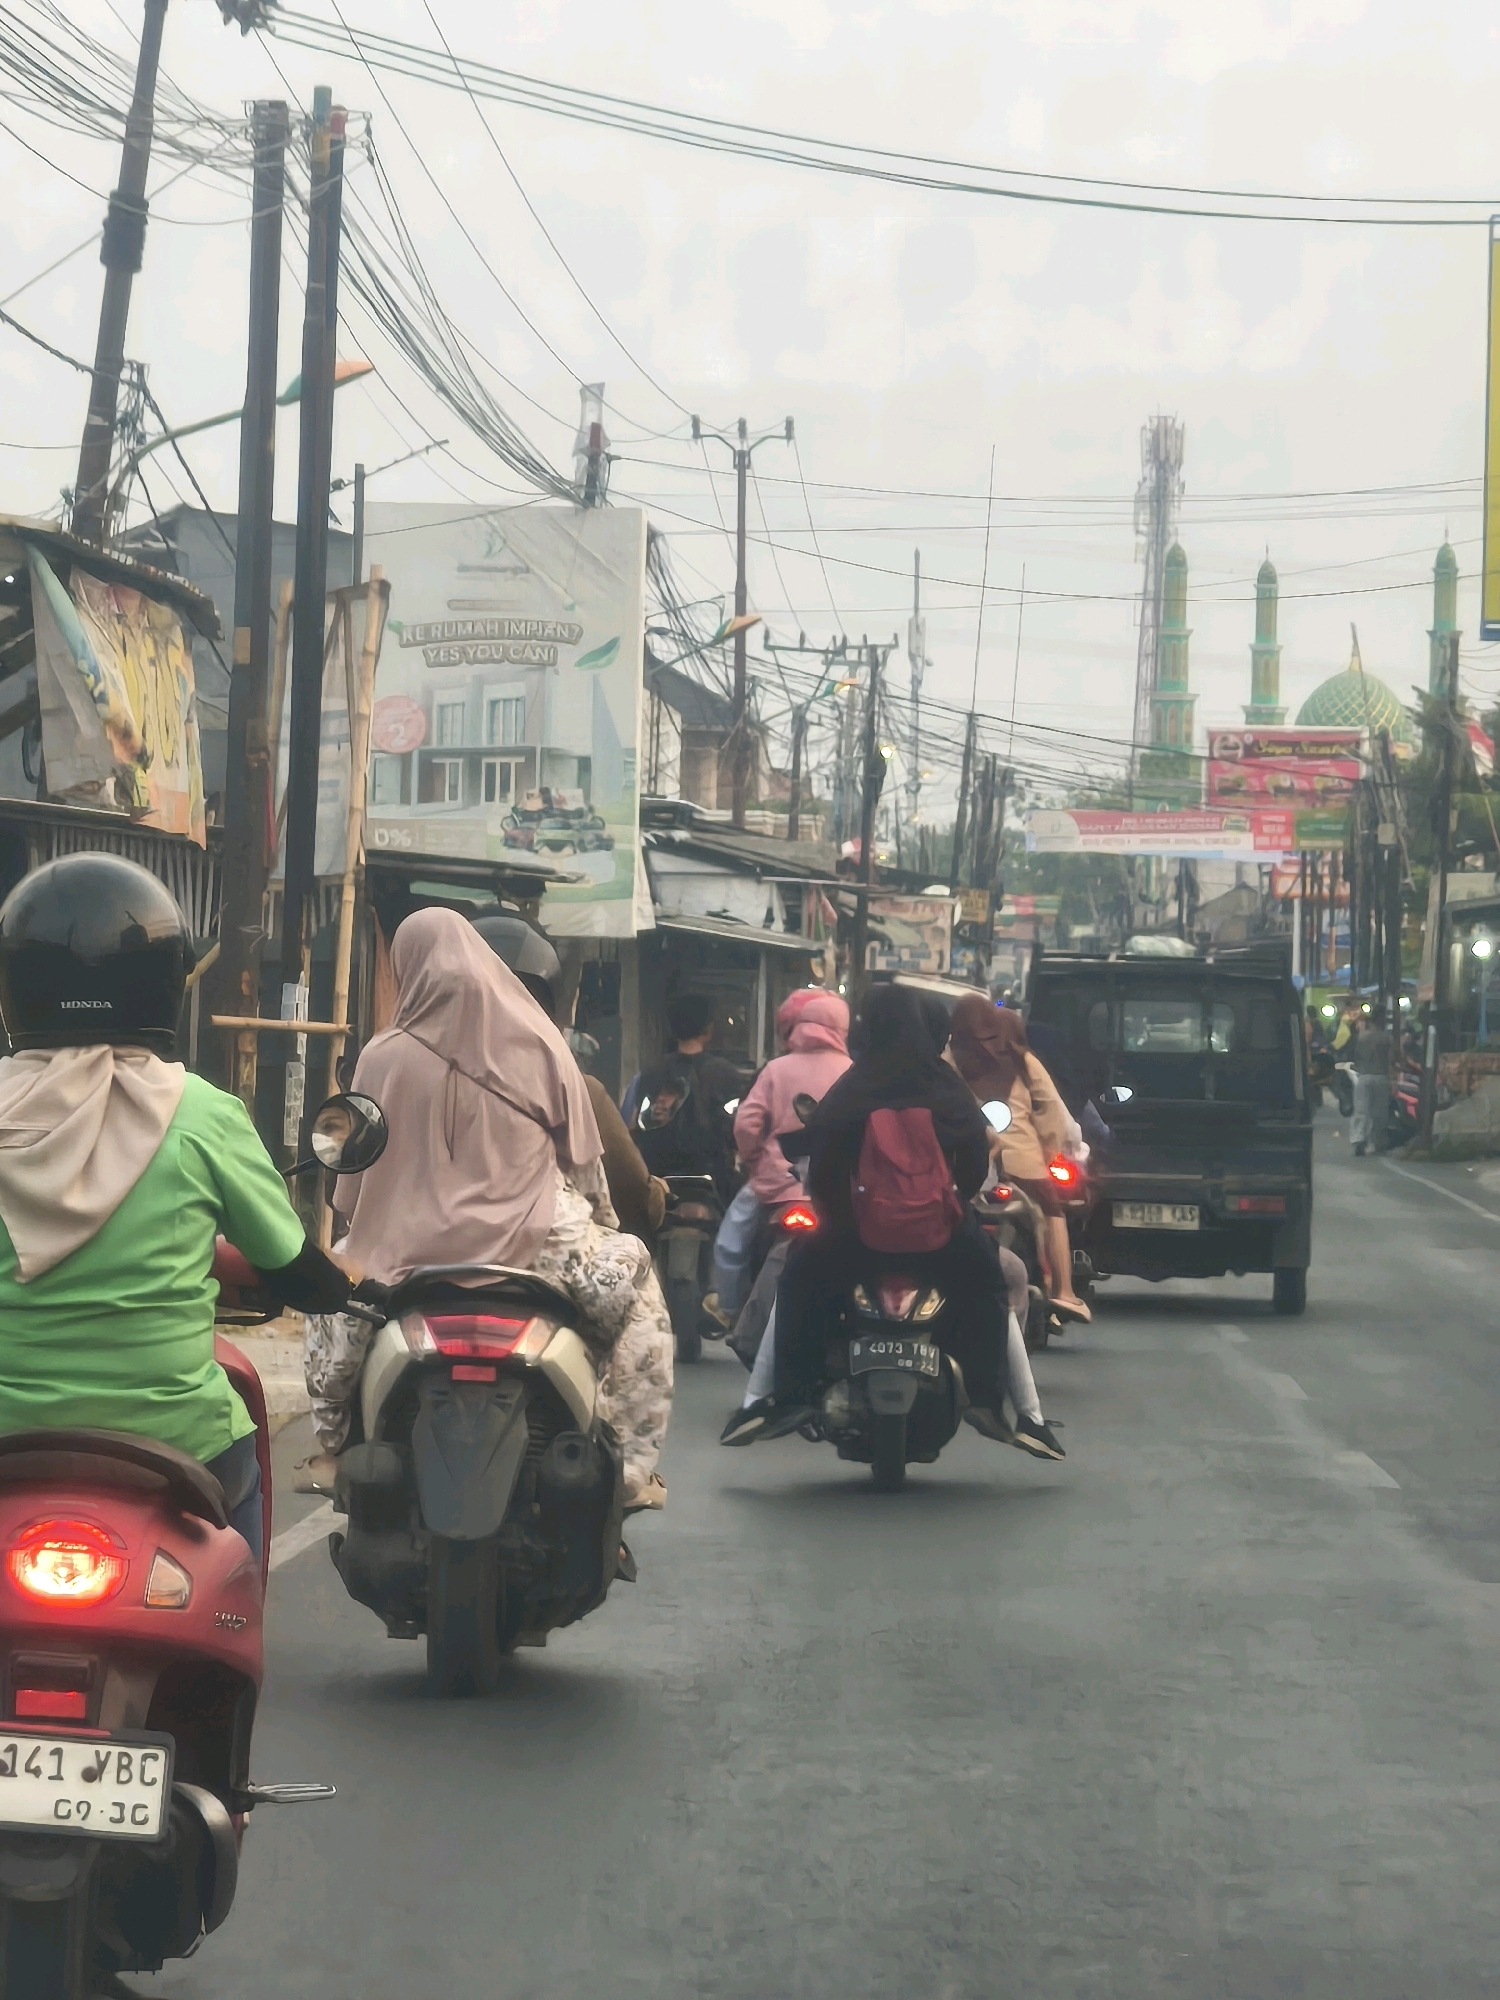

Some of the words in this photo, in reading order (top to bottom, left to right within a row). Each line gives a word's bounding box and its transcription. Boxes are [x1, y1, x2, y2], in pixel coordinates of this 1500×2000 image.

[428, 647, 460, 662] YES
[466, 645, 504, 661] YOU
[374, 827, 412, 848] 0%
[60, 1000, 113, 1009] HONDA
